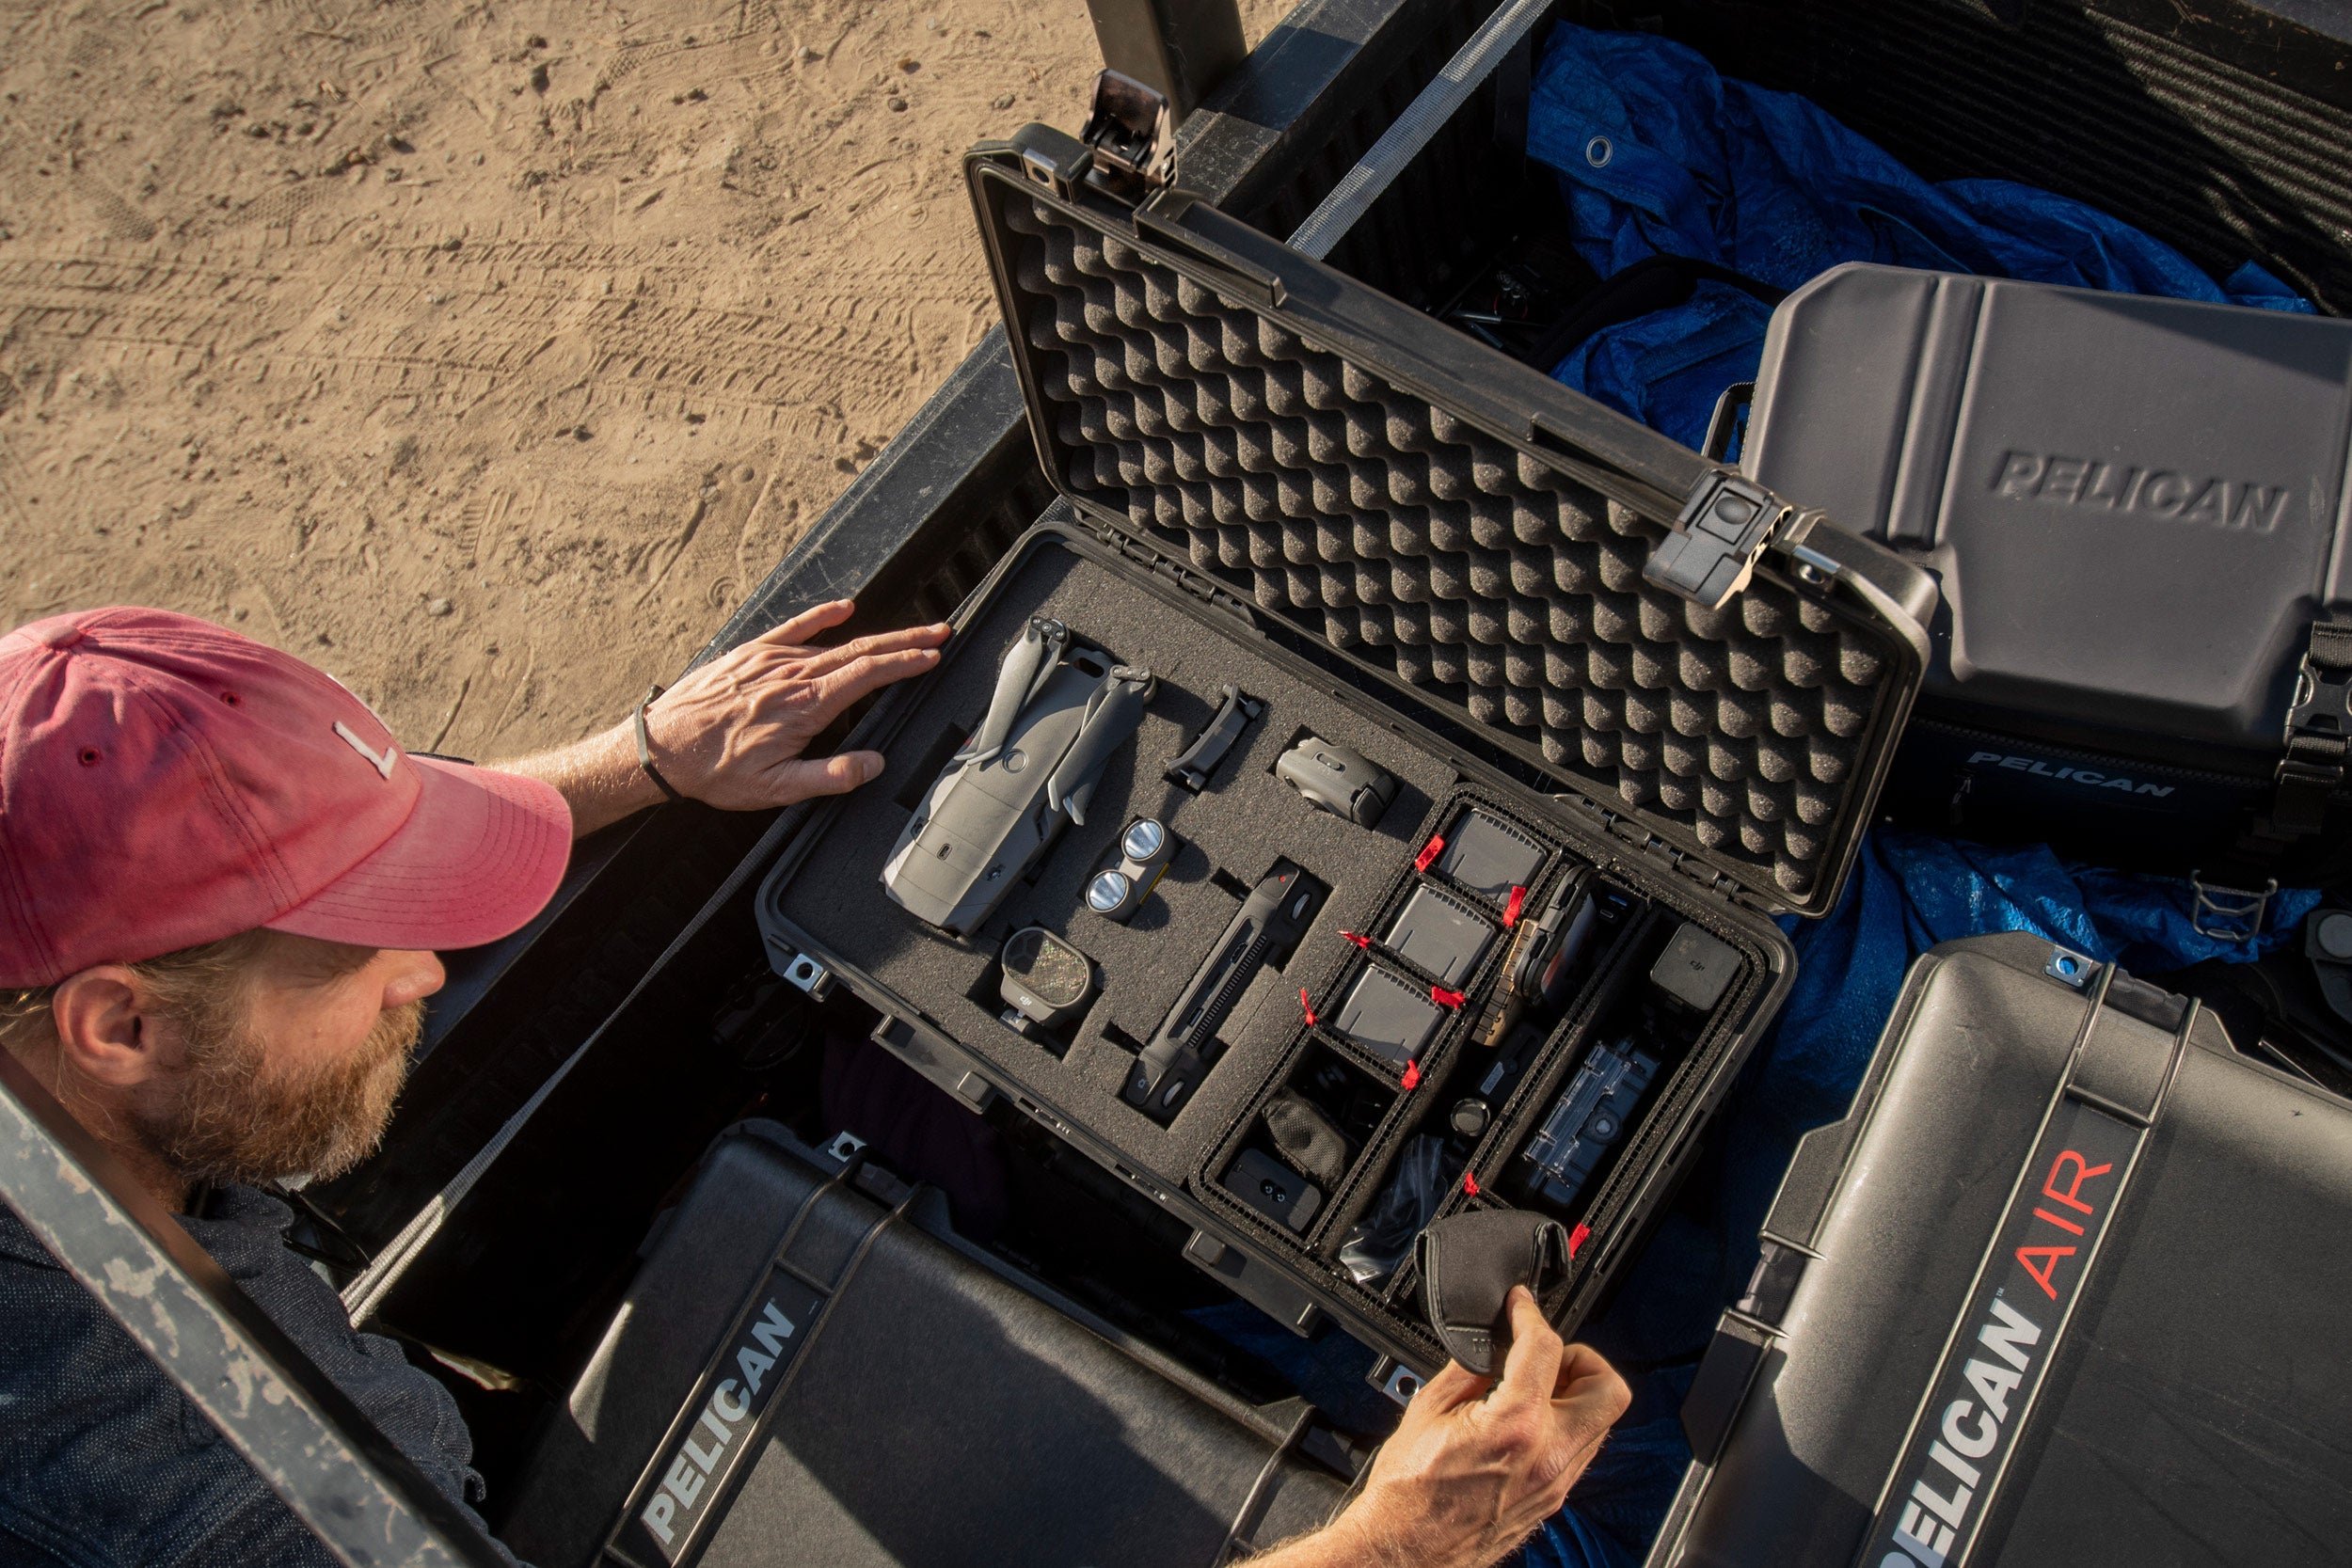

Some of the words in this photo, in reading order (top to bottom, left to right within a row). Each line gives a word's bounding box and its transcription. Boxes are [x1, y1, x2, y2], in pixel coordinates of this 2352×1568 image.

[1990, 450, 2289, 533] PELICAN
[1967, 752, 2175, 797] PELICAN
[2015, 1149, 2112, 1301] AIR
[641, 1301, 795, 1544] PELICAN
